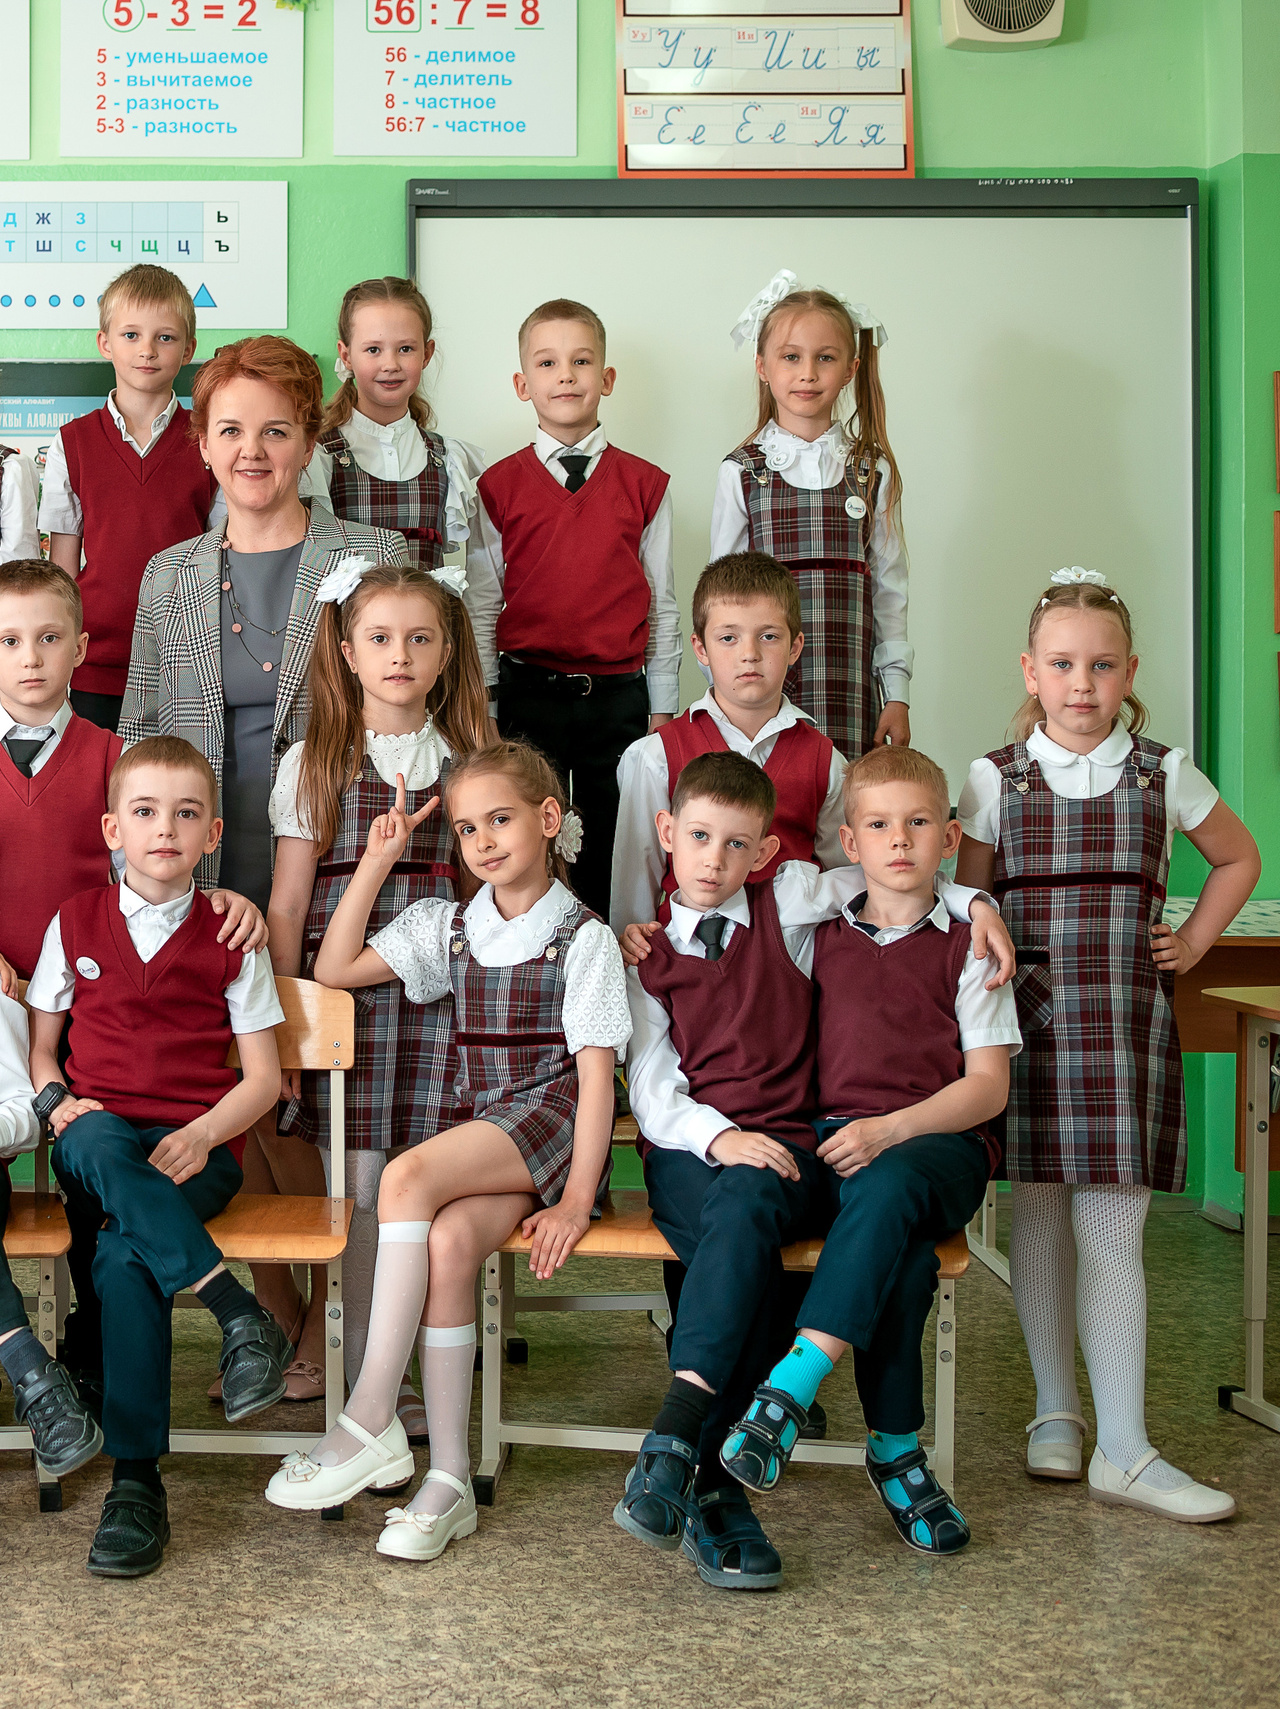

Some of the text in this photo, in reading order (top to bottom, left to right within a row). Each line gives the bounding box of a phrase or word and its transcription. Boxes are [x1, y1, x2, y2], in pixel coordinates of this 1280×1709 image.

[113, 0, 134, 26] 5
[171, 0, 189, 26] 3
[238, 0, 256, 26] 2
[374, 0, 415, 25] 56
[454, 0, 471, 24] 7
[521, 0, 539, 25] 8
[97, 49, 106, 63] 5
[127, 52, 268, 67] уменьшаемое
[386, 47, 406, 62] 56
[426, 51, 515, 65] делимое
[97, 72, 106, 86] 3
[127, 75, 252, 87] вычитаемое
[385, 71, 395, 85] 7
[414, 74, 512, 88] делитель
[97, 95, 106, 109] 2
[127, 98, 219, 113] разность
[385, 94, 395, 109] 8
[416, 97, 496, 109] частное
[633, 106, 648, 116] Ее
[97, 118, 124, 133] 5-3
[145, 122, 237, 137] разность
[386, 117, 425, 132] 56:7
[446, 121, 526, 132] частное
[3, 213, 17, 227] д
[36, 213, 51, 224] ж
[76, 213, 85, 224] з
[217, 211, 228, 223] ь
[5, 240, 15, 252] т
[37, 240, 51, 252] ш
[76, 240, 86, 252] с
[111, 240, 121, 252] ч
[142, 240, 158, 255] щ
[178, 240, 189, 255] ц
[215, 240, 229, 252] ъ
